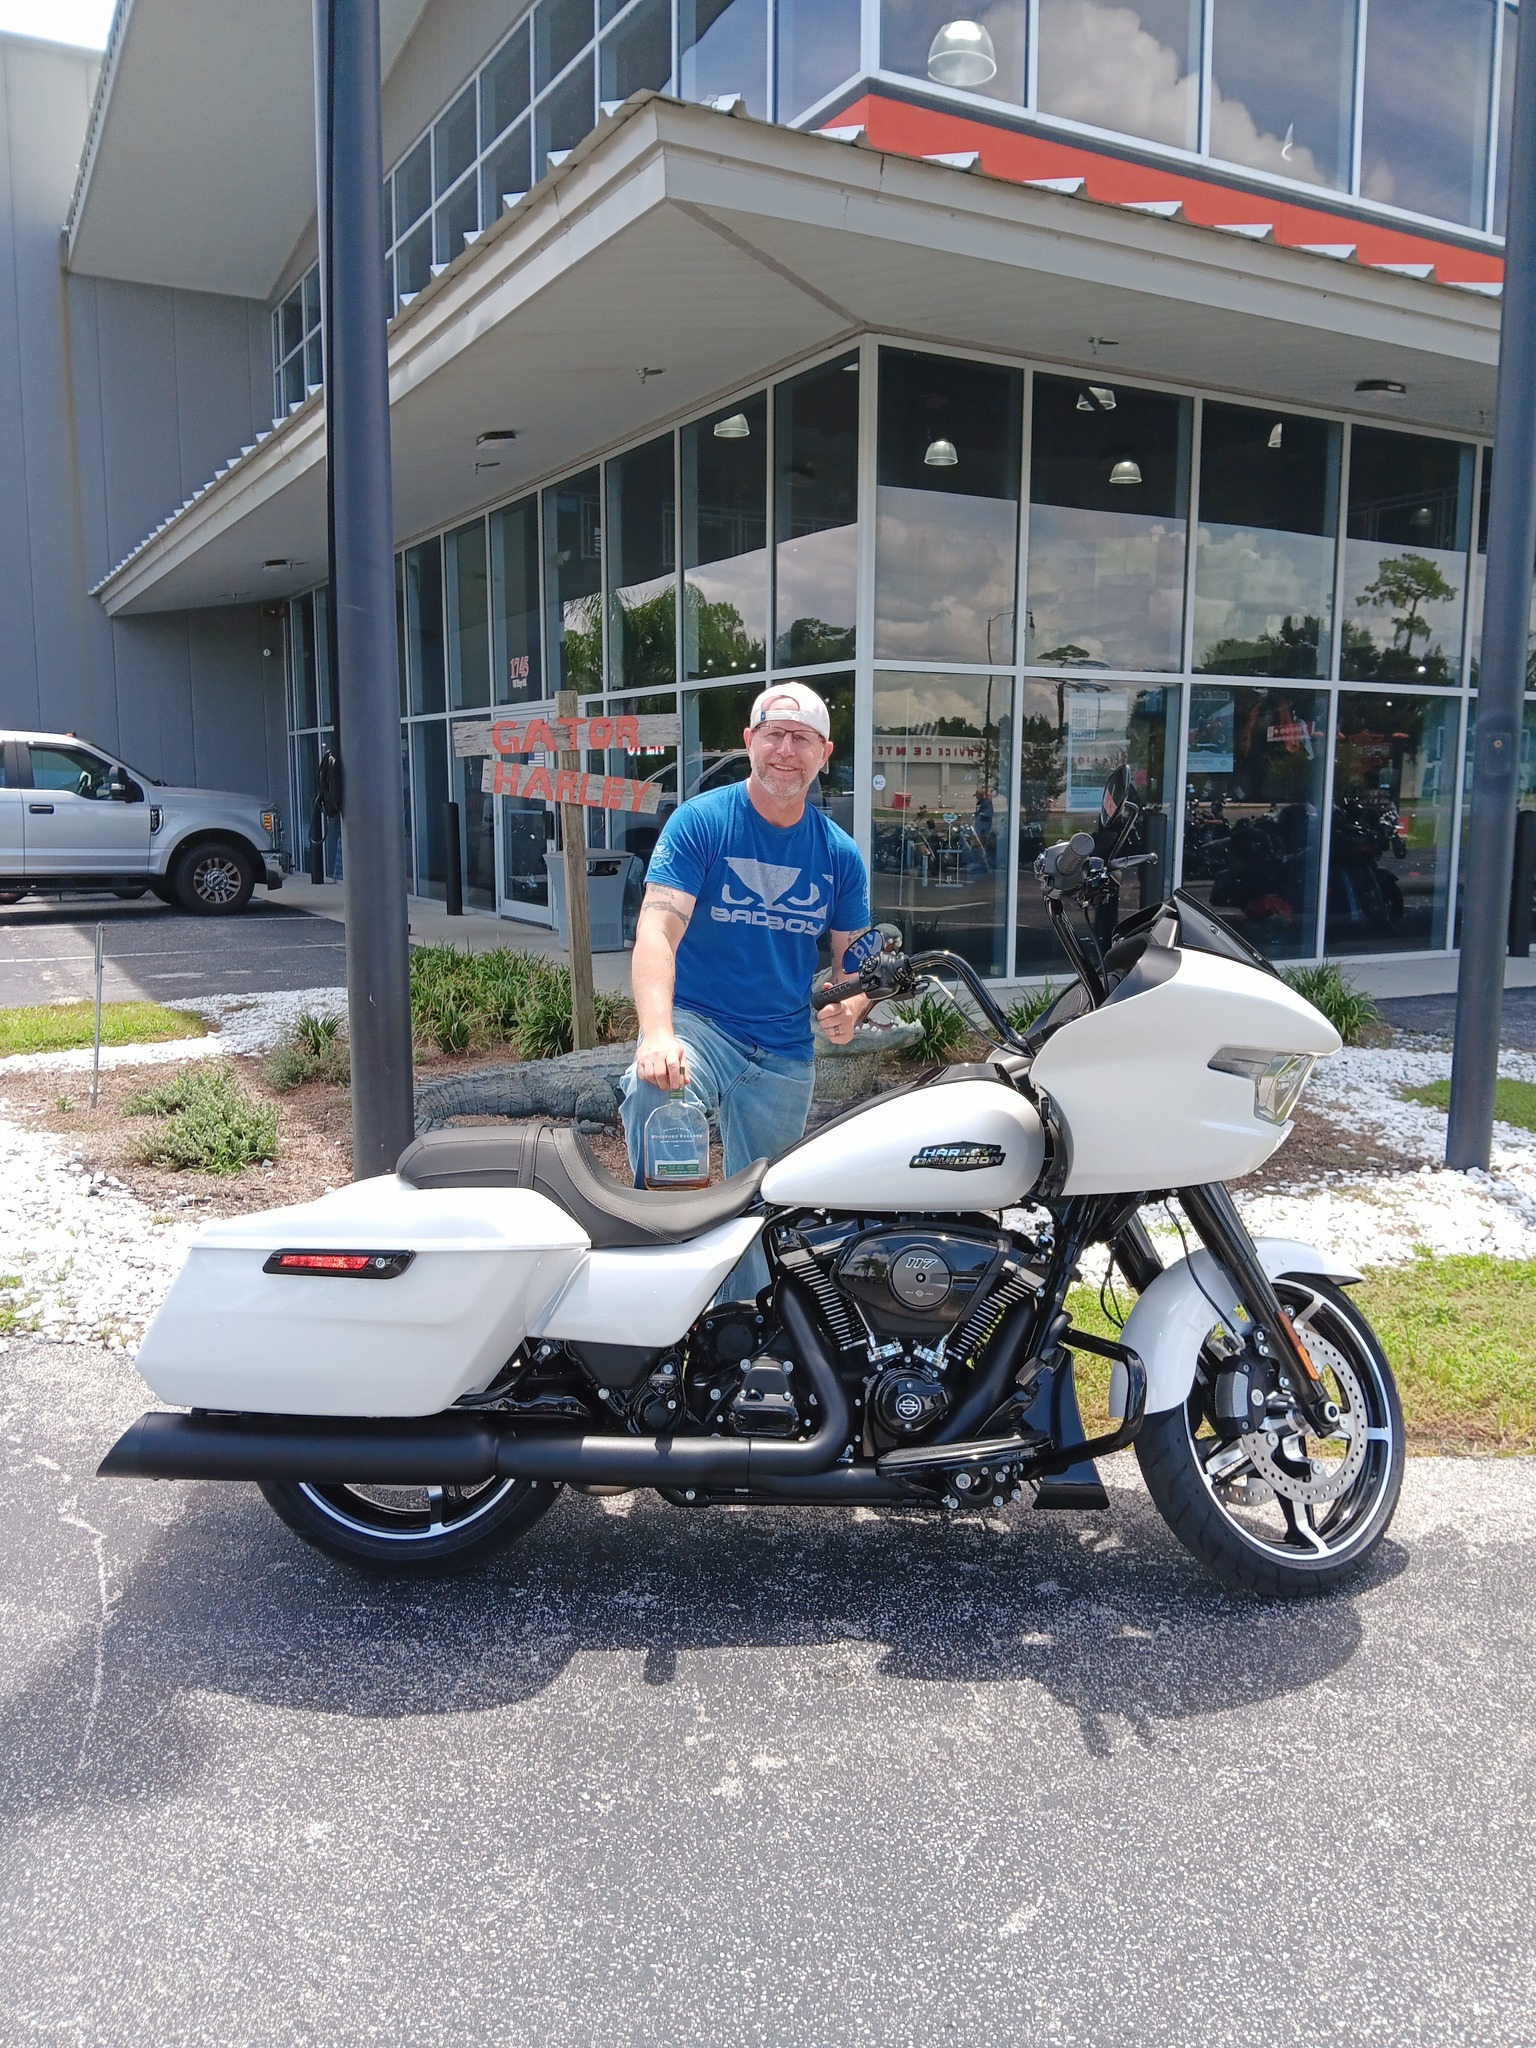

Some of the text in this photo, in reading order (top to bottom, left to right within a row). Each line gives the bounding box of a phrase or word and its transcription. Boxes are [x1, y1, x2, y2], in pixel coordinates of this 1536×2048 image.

[510, 656, 529, 678] 1745
[492, 716, 641, 754] GATOR
[493, 762, 651, 813] HARLEY
[913, 1156, 1002, 1165] DAVIDSON
[905, 1257, 938, 1269] 117
